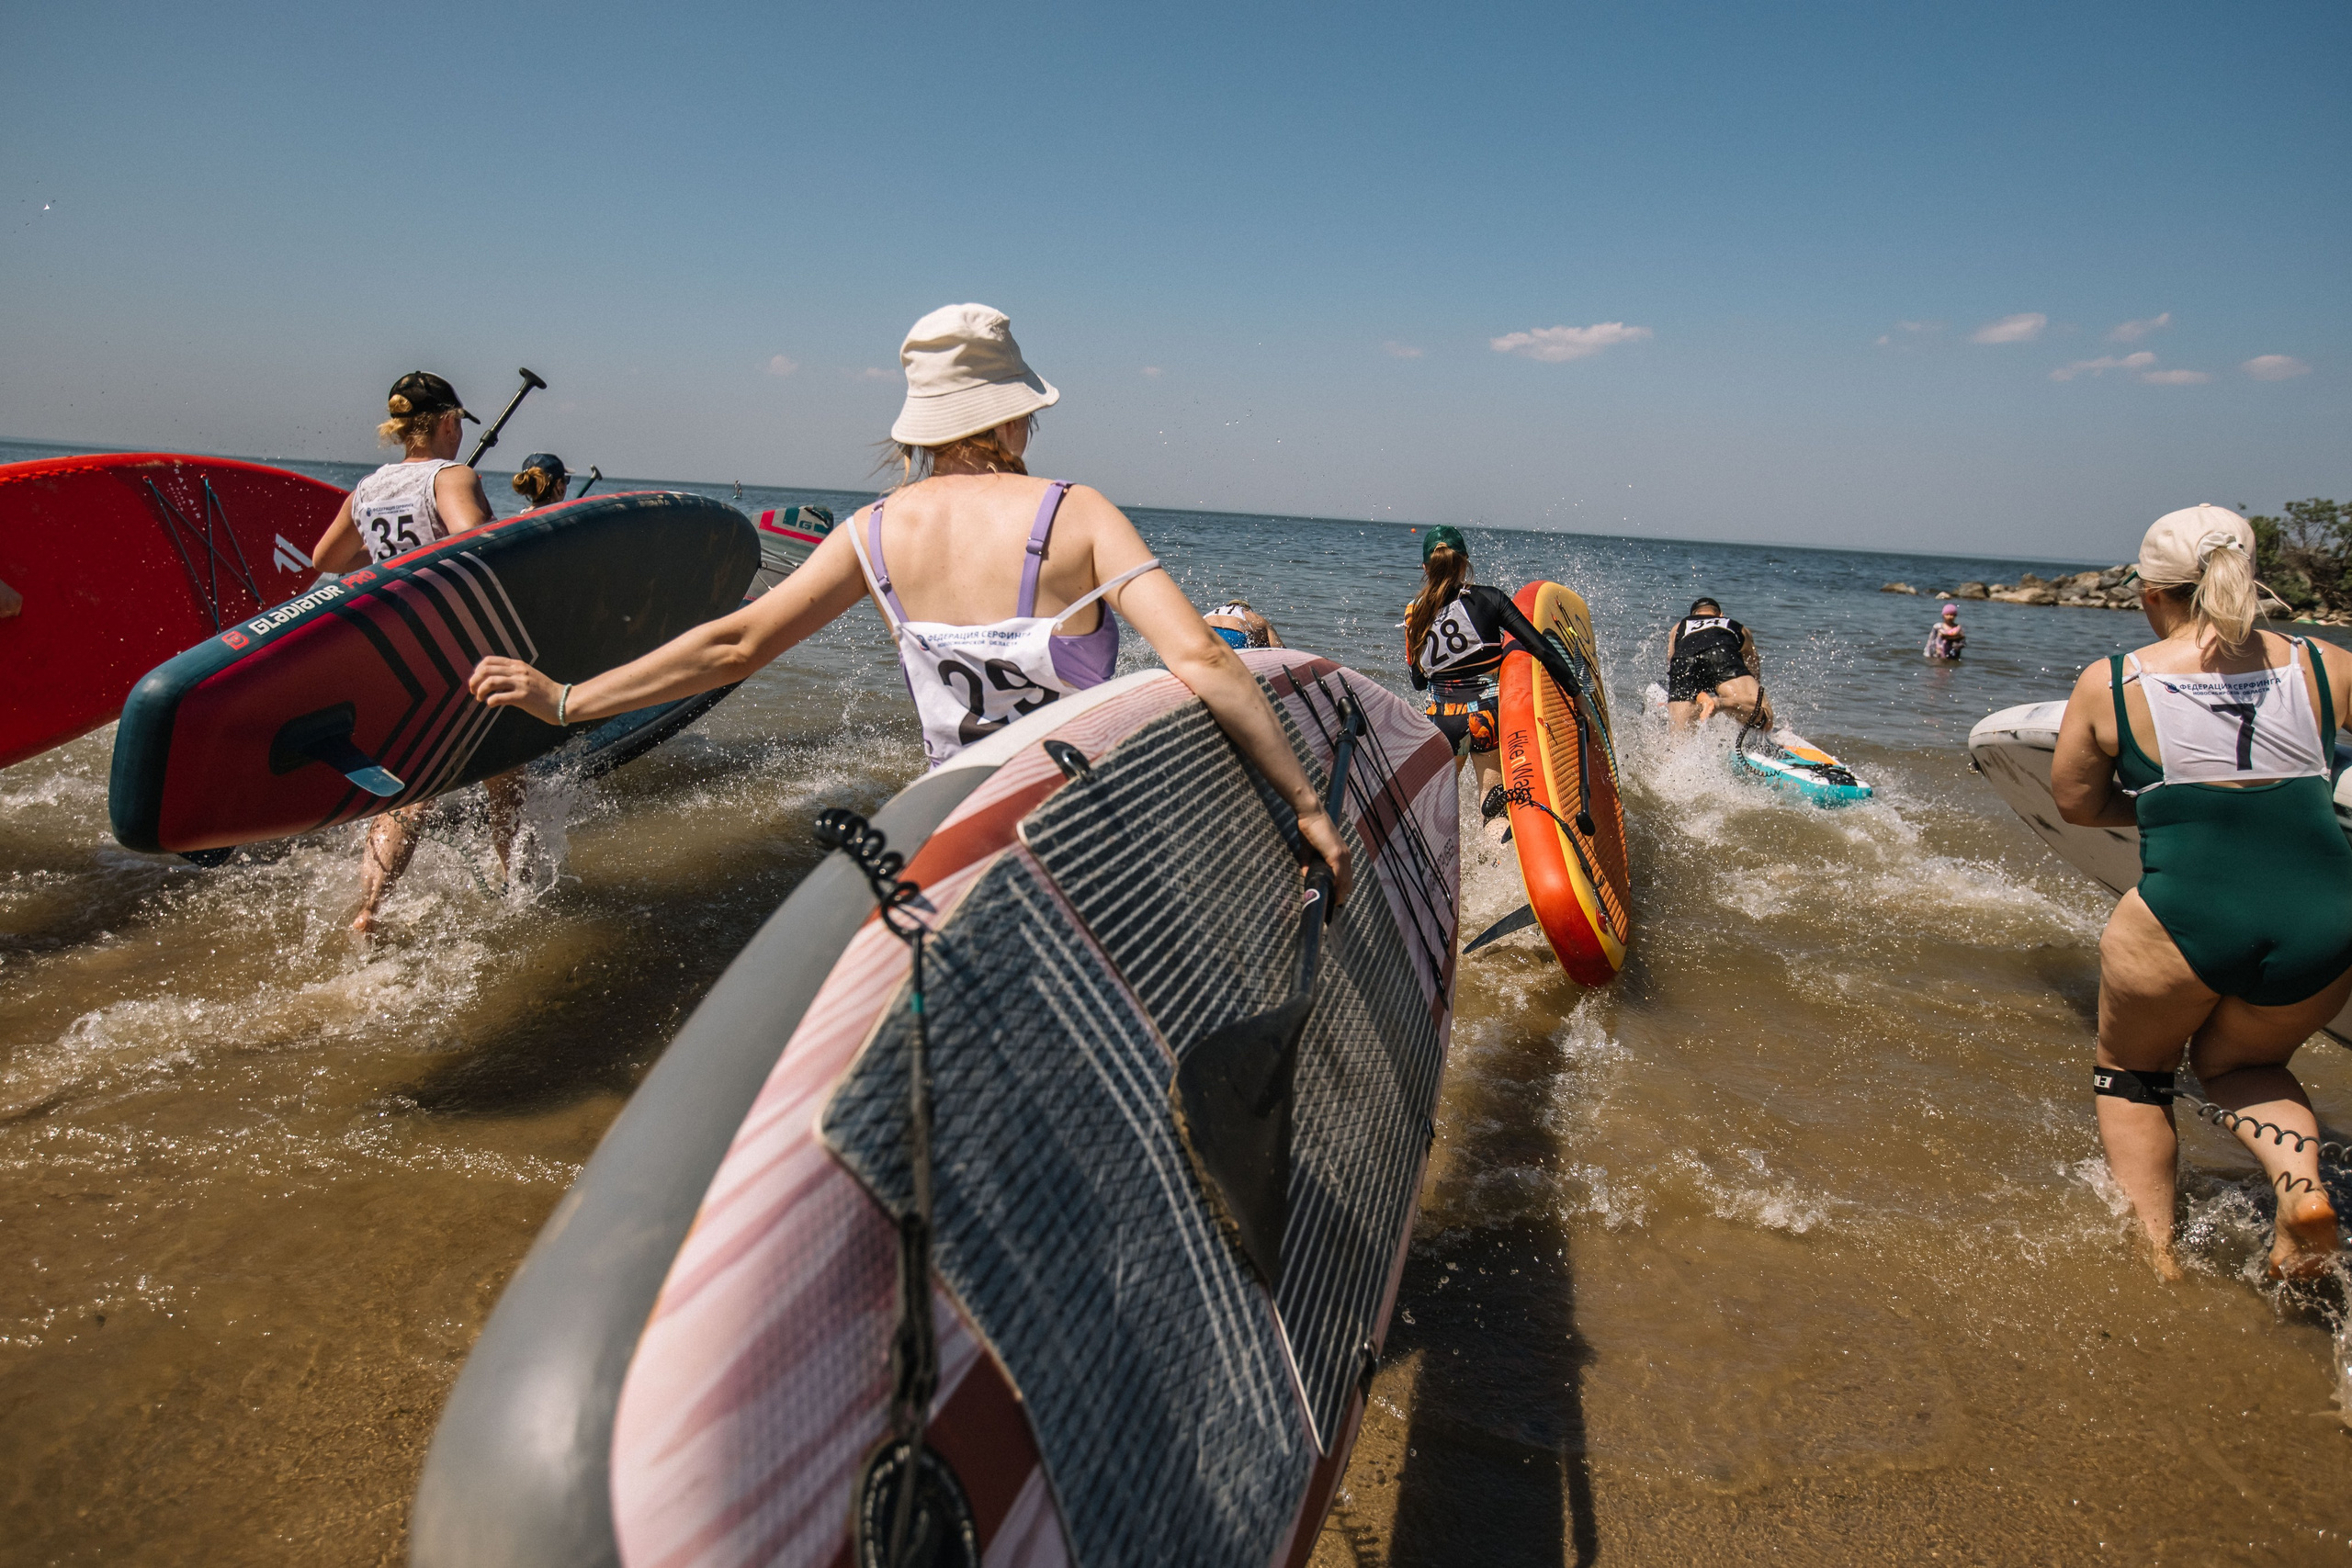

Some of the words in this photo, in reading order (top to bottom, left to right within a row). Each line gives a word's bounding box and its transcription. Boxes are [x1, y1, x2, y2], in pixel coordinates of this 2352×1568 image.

[174, 468, 188, 491] RAY
[188, 499, 201, 519] AIR
[371, 514, 421, 560] 35
[248, 584, 345, 636] GLADIATOR
[340, 570, 378, 590] PRO
[927, 631, 979, 642] ФЕДЕРАЦИЯ
[1425, 619, 1468, 667] 28
[938, 659, 1059, 745] 29
[2179, 682, 2233, 692] ФЕДЕРАЦИЯ
[2233, 677, 2281, 691] СЕРФИНГА
[2243, 687, 2270, 695] ОБЛАСТИ
[2210, 703, 2256, 771] 7
